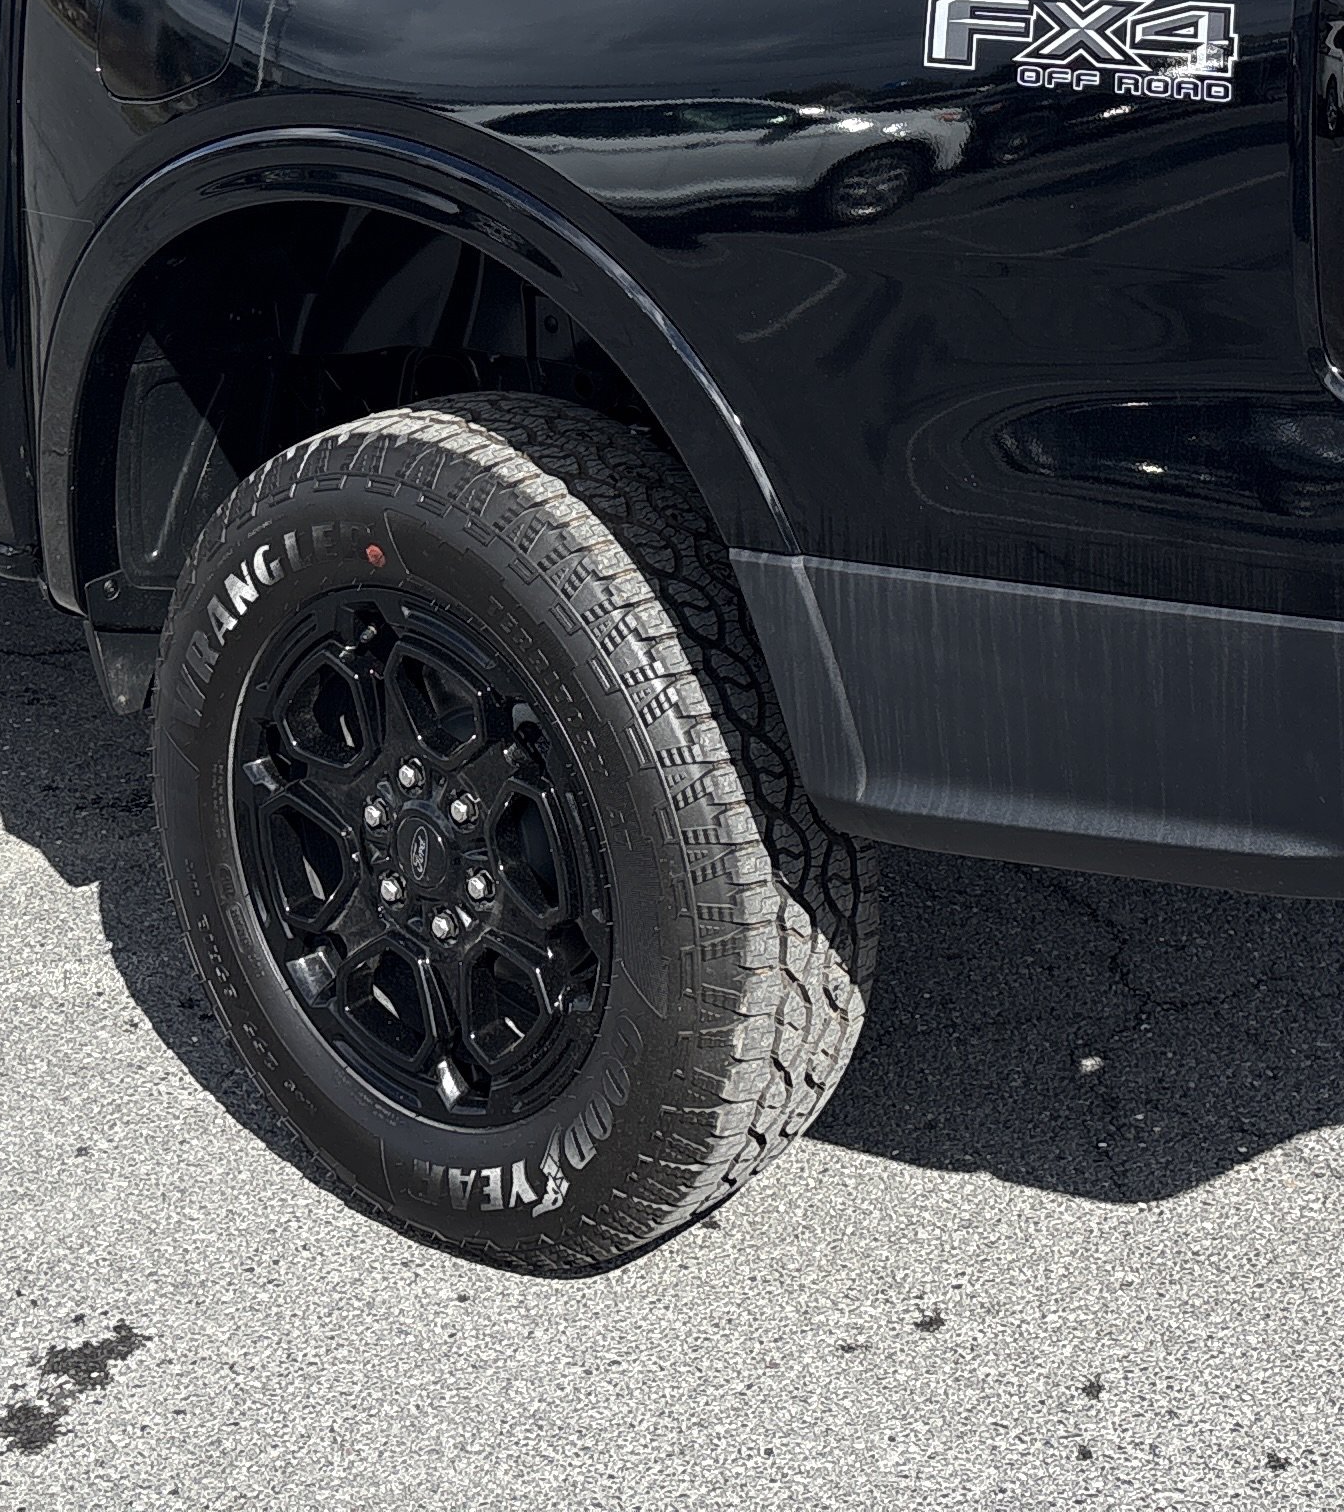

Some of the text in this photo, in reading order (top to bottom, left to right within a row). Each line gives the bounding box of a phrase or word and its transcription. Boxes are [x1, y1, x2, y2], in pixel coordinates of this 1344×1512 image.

[1016, 65, 1233, 103] OFF ROAD
[171, 519, 370, 729] WRANGLER
[411, 1012, 644, 1214] GOODYEAR
